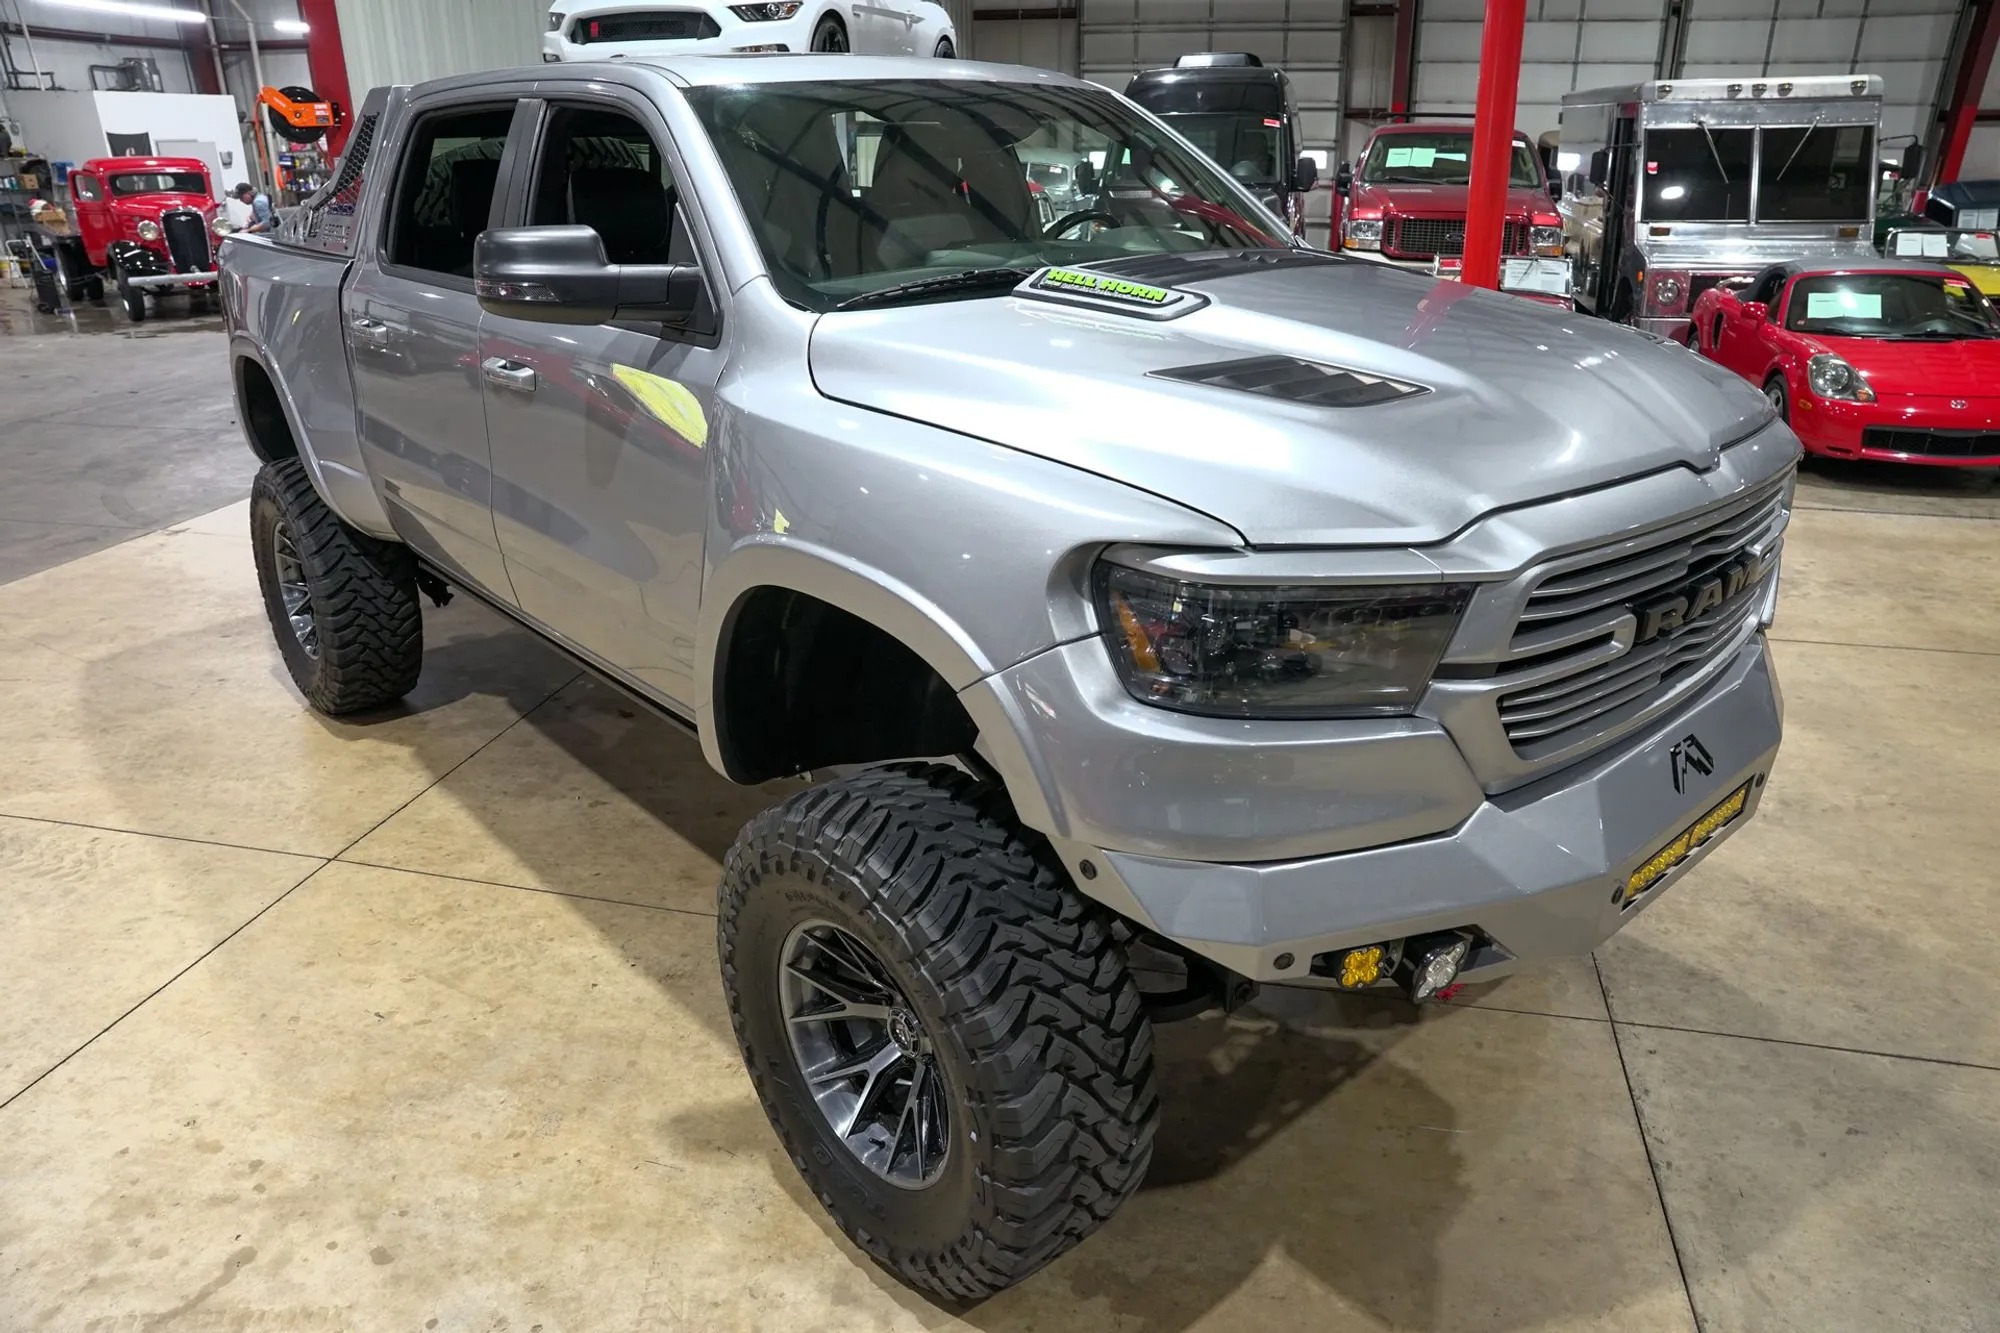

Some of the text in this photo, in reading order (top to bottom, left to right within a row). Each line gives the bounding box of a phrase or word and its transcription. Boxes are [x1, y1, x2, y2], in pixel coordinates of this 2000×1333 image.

[1047, 267, 1168, 303] HELL HORN
[1633, 551, 1760, 643] RAM
